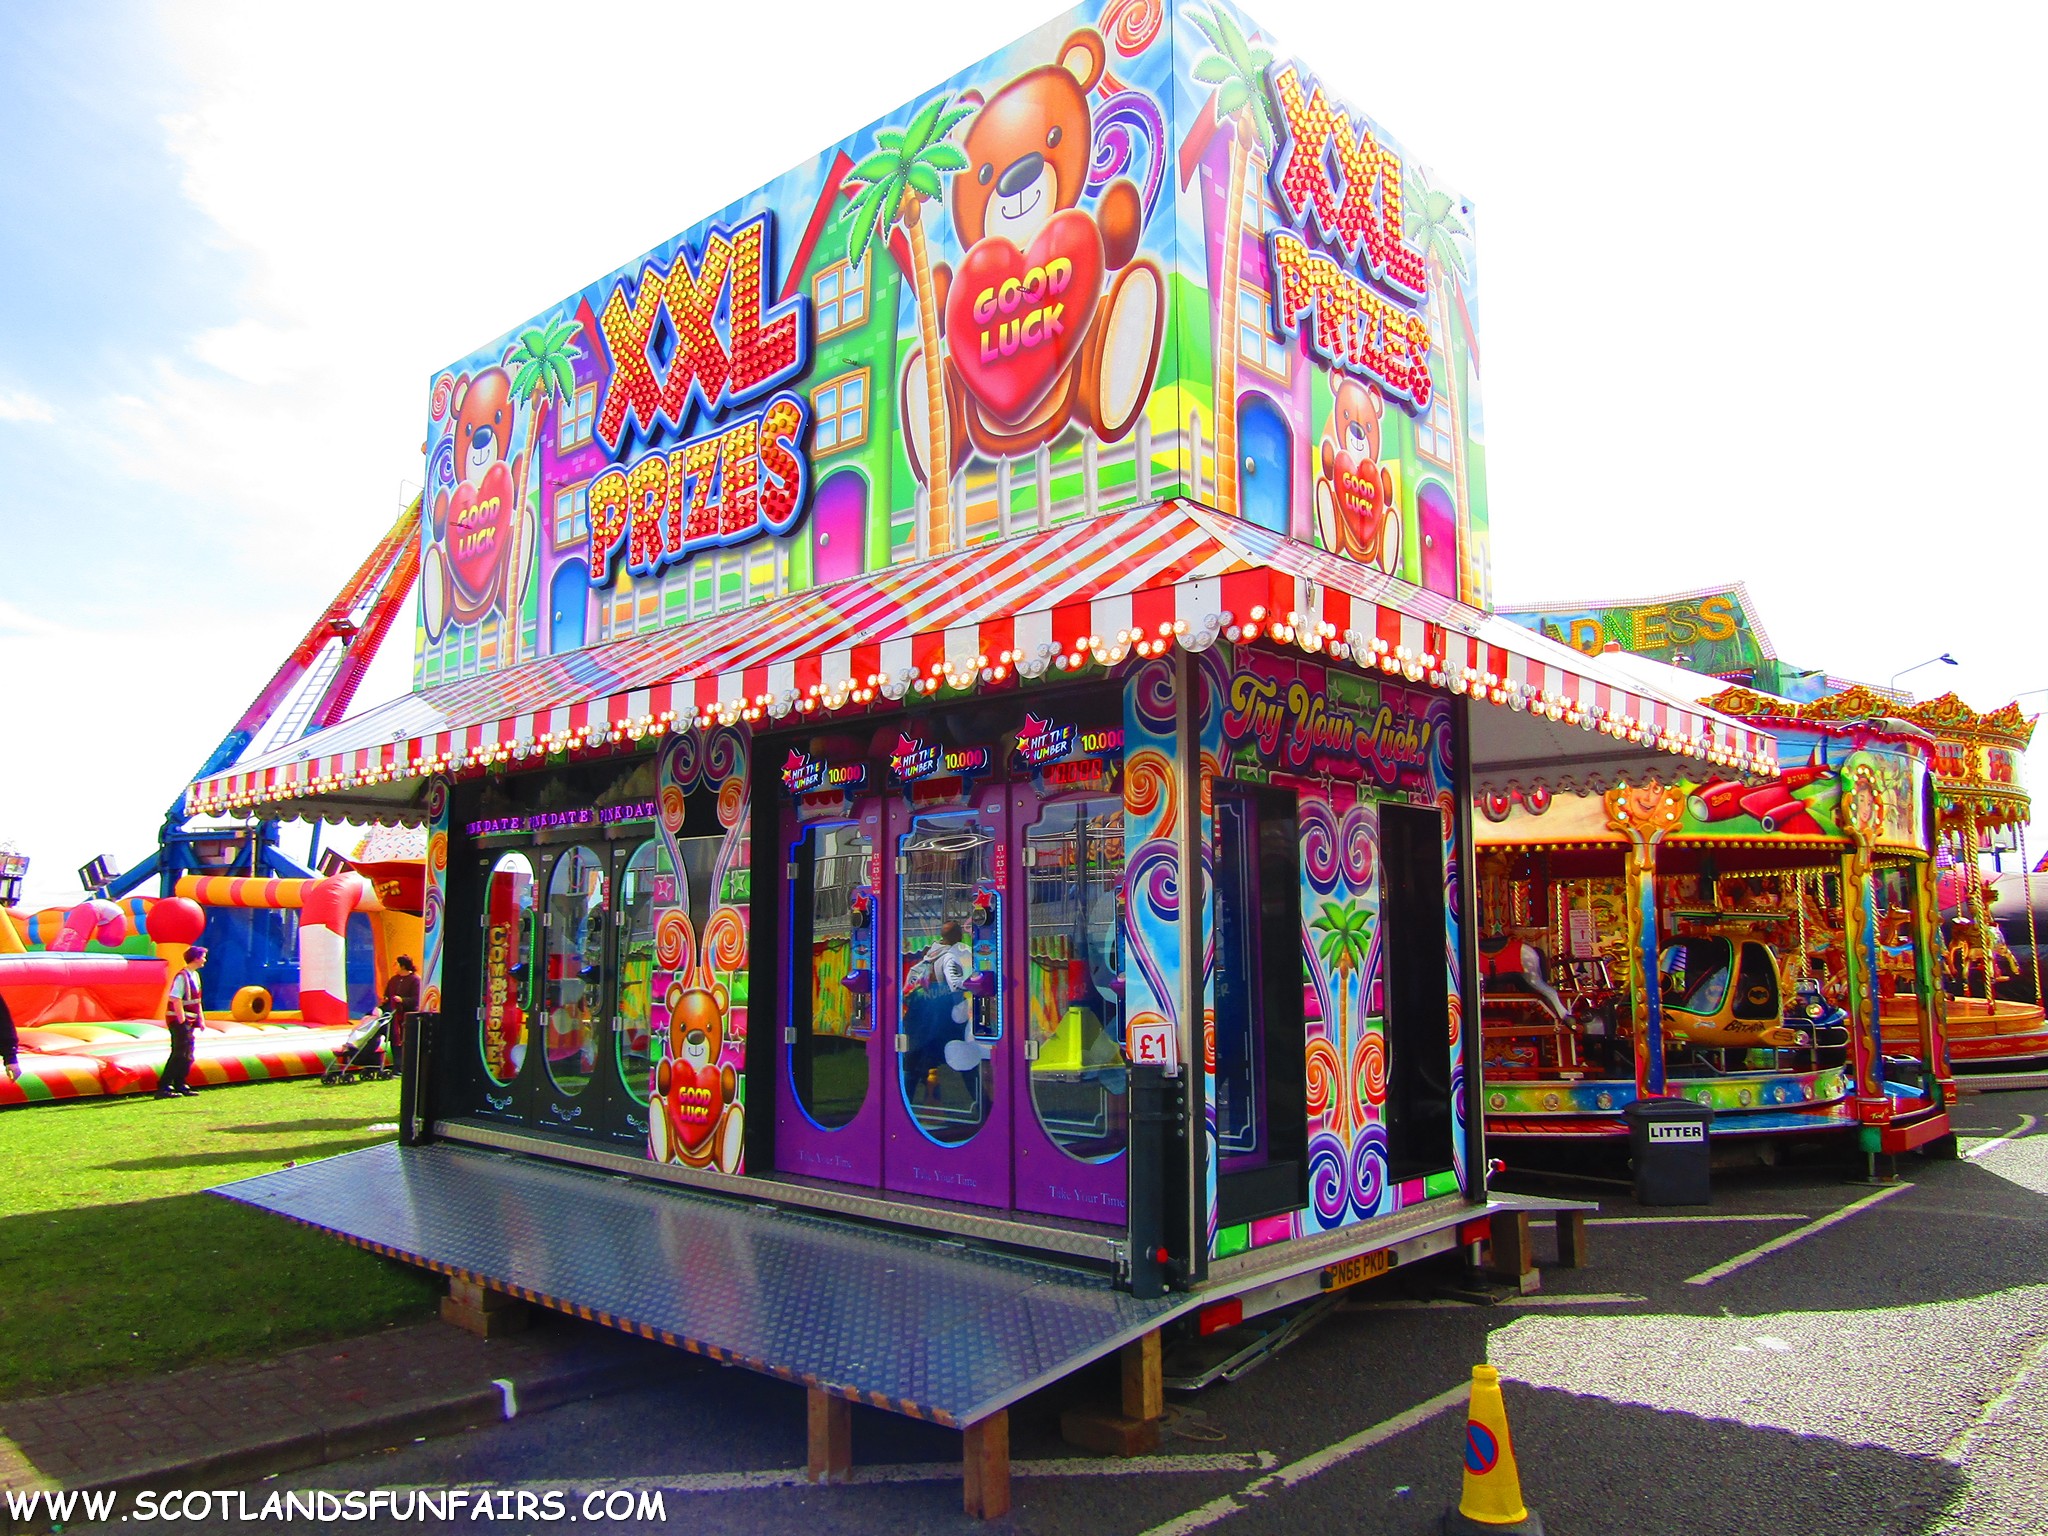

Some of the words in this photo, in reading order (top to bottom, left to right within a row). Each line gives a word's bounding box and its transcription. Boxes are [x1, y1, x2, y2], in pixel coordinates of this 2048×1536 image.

[1276, 66, 1427, 296] XXL
[973, 257, 1072, 324] GOOD
[1276, 233, 1432, 407] PRIZES
[597, 222, 798, 450] XXL
[980, 302, 1064, 364] LUCK
[588, 399, 804, 580] PRIZES
[1343, 472, 1375, 499] GOOD
[457, 496, 501, 533] GOOD
[1345, 492, 1373, 517] LUCK
[457, 526, 496, 560] LUCK
[1031, 733, 1048, 750] HIT
[1050, 726, 1071, 743] THE
[1223, 675, 1285, 755] Try
[1288, 683, 1353, 766] Your
[1355, 705, 1431, 784] Luck!
[903, 753, 918, 768] HIT
[919, 746, 937, 761] THE
[945, 750, 982, 770] 10.000
[792, 767, 805, 780] HIT
[828, 765, 862, 783] 10.000
[549, 810, 589, 825] DATE
[625, 802, 655, 818] DAT
[483, 817, 520, 832] DATE
[1140, 1033, 1167, 1059] £1
[679, 1086, 711, 1105] GOOD
[680, 1104, 708, 1123] LUCK
[1651, 1127, 1701, 1138] LITTER
[1100, 1193, 1126, 1207] Time
[1363, 1251, 1384, 1275] PKD
